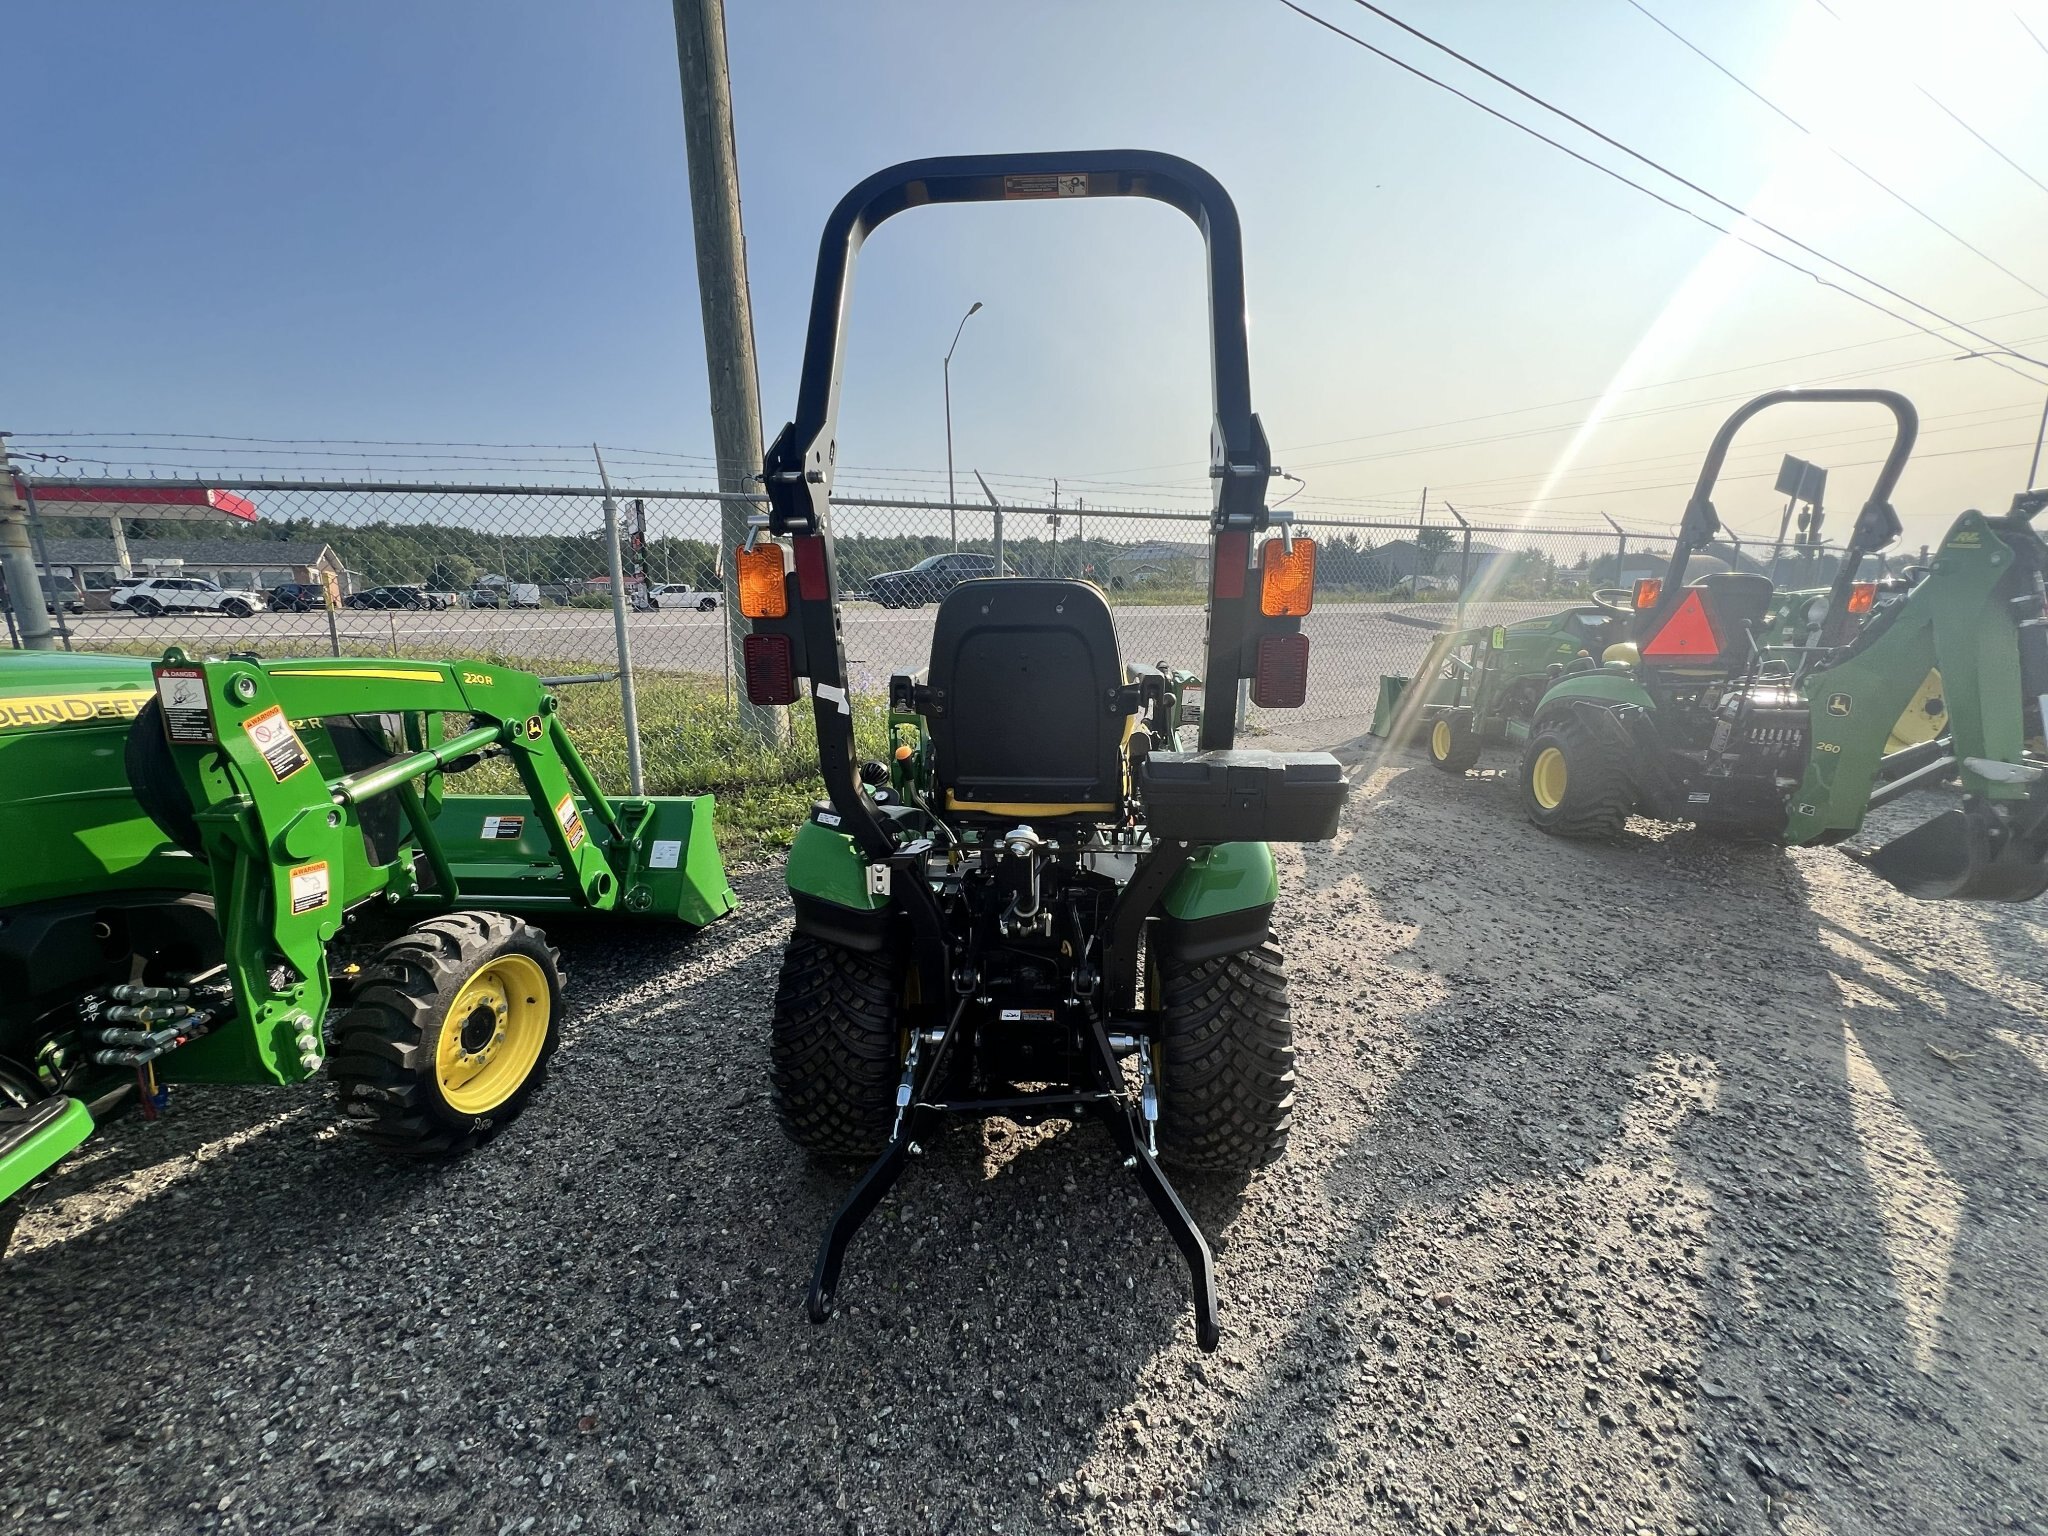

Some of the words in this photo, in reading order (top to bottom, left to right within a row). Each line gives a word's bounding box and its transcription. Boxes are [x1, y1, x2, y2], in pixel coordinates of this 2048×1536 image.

[251, 706, 279, 724] WARNING
[1816, 741, 1841, 754] 260
[299, 862, 326, 874] WARNING
